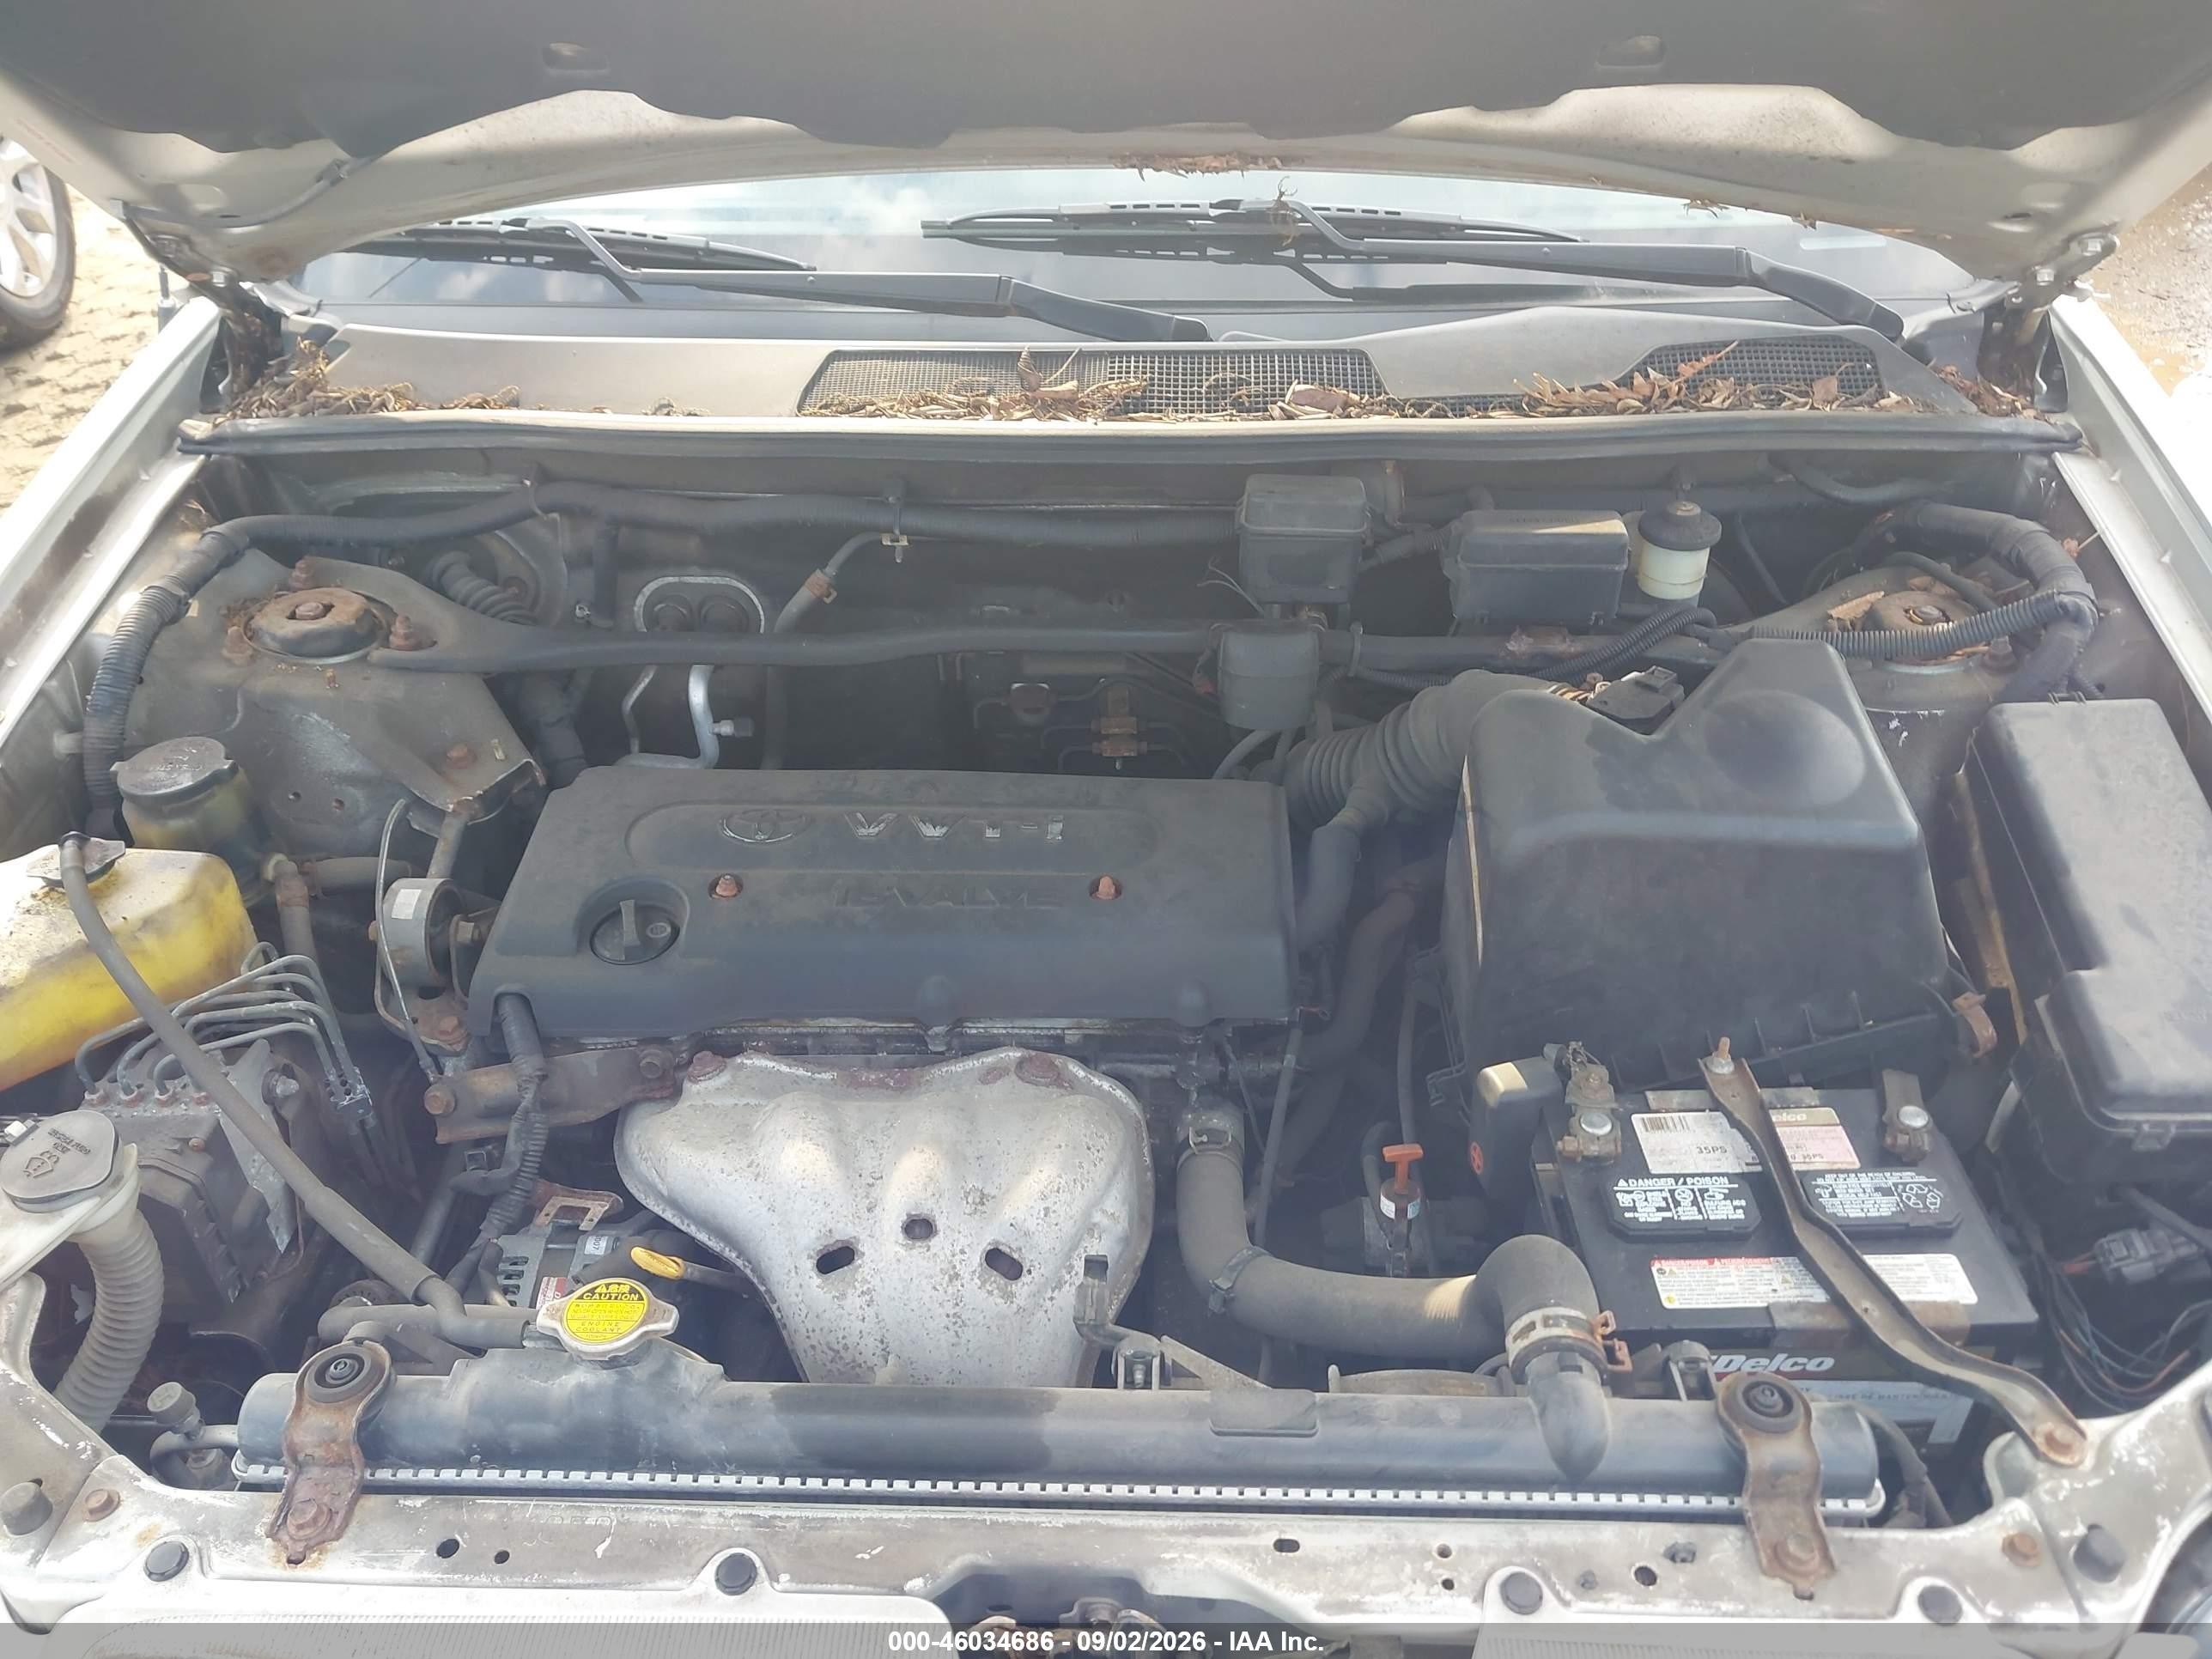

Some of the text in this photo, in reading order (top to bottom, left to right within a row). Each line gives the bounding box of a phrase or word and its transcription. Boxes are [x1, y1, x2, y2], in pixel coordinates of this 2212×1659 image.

[1627, 1177, 1676, 1187] DANGER
[1686, 1176, 1729, 1187] POISON
[582, 1292, 639, 1301] CAUTION
[1712, 1352, 1835, 1373] Delco
